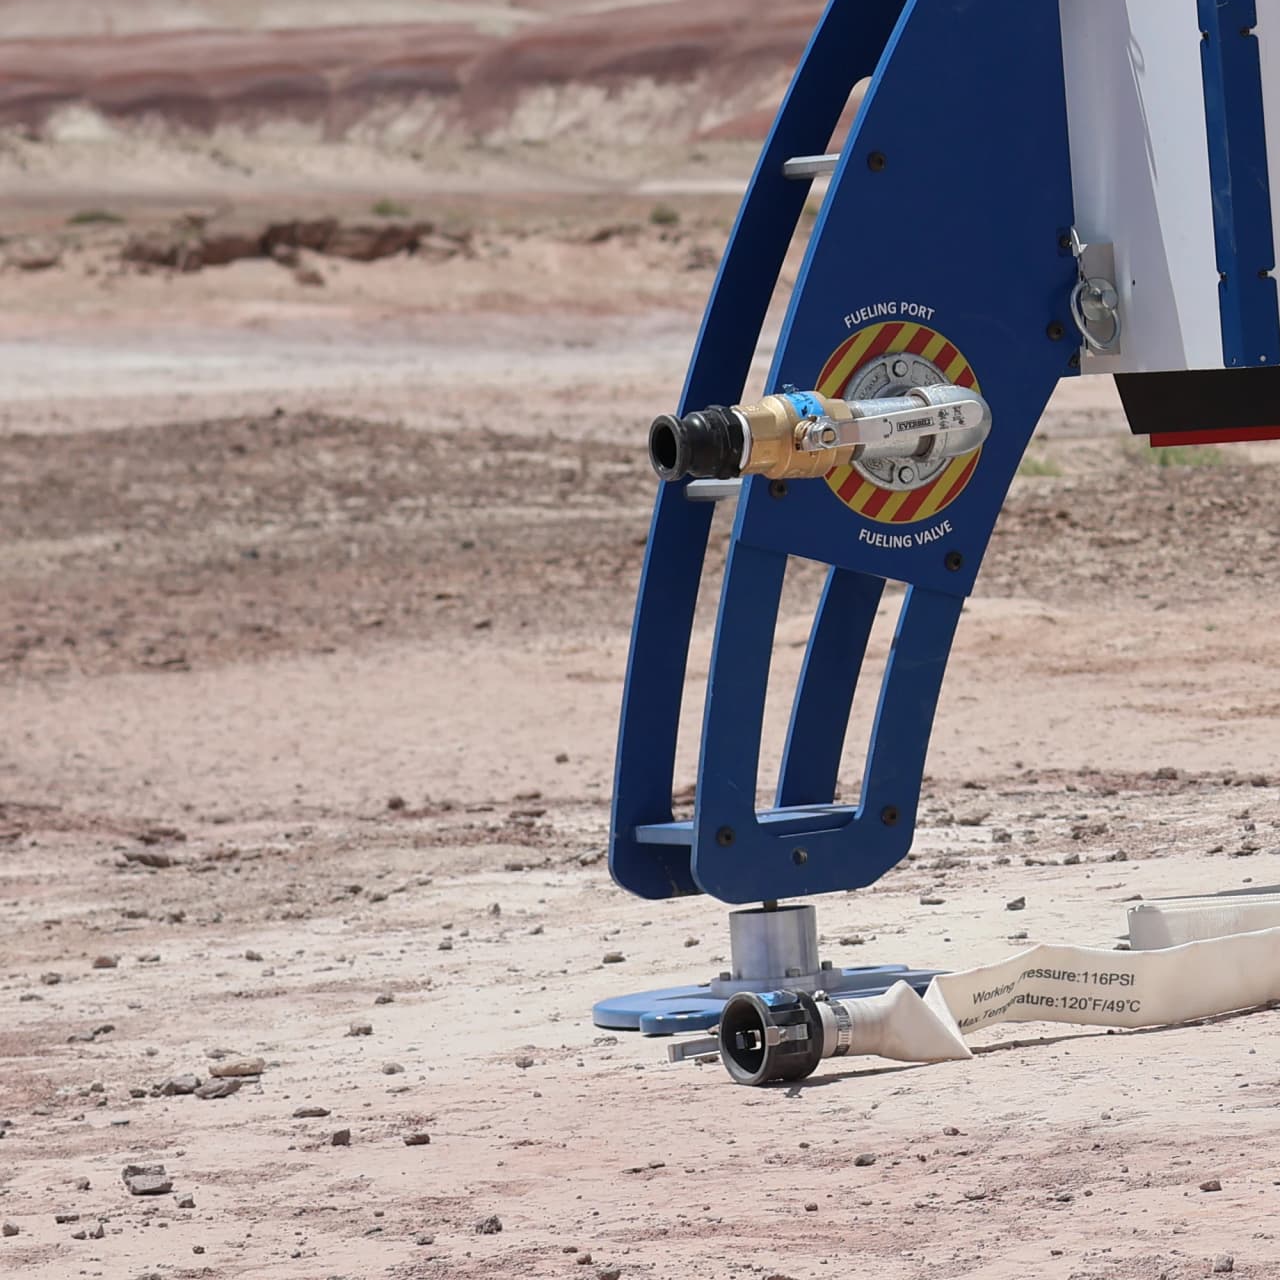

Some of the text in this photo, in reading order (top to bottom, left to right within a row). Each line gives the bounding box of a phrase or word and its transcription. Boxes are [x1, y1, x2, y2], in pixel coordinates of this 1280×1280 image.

[844, 302, 936, 329] FUELING PORT
[858, 519, 953, 549] FUELING VALVE
[972, 981, 1015, 1006] Working
